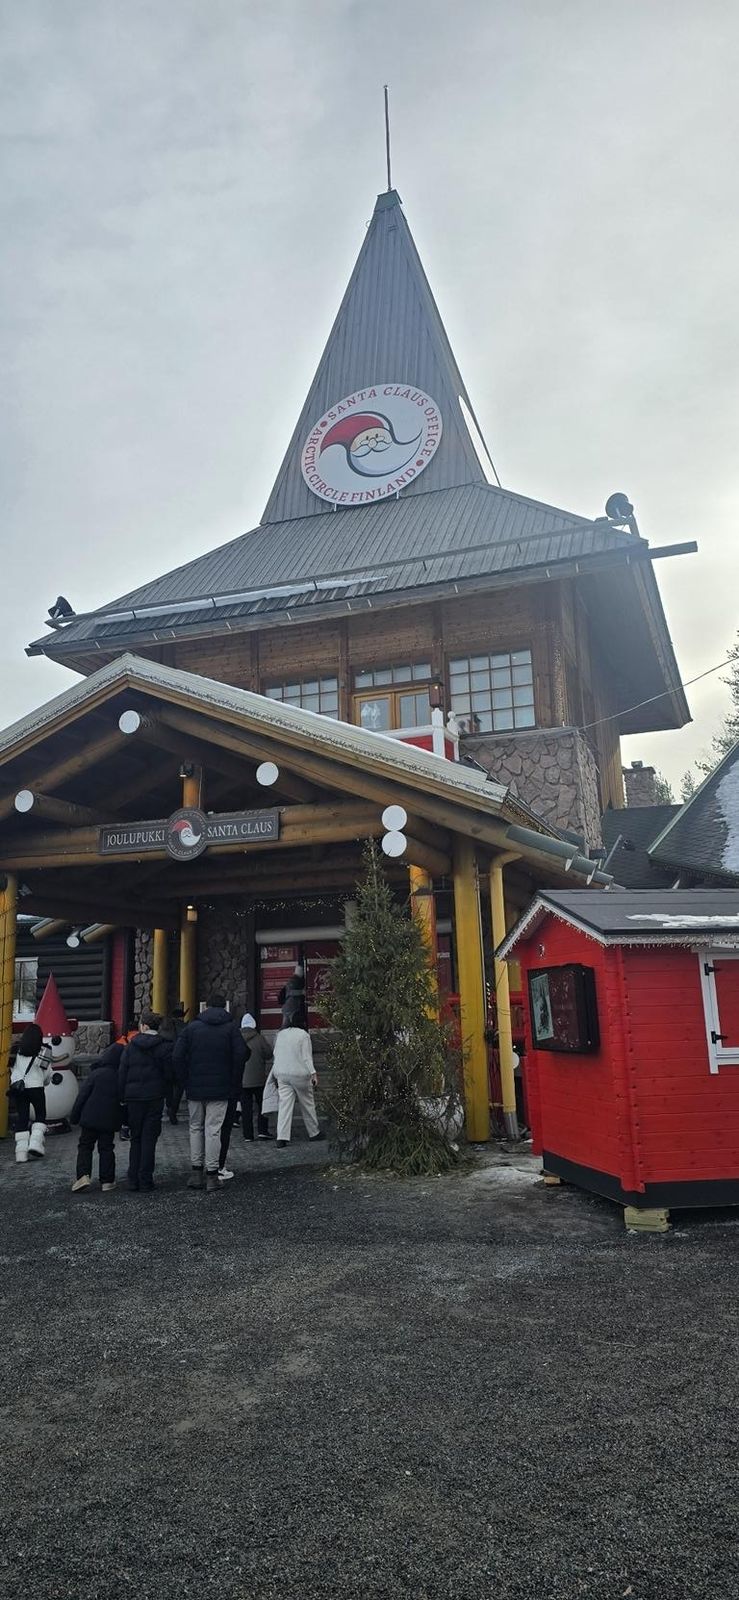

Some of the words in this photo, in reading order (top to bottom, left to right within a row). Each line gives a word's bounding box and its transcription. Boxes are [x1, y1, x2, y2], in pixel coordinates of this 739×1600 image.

[327, 388, 377, 421] SANTA
[383, 386, 428, 407] CLAUS
[422, 407, 439, 457] OFFICE
[304, 428, 323, 474] ARCTIC
[308, 474, 349, 502] CIRCLE
[350, 467, 416, 502] FINLAND
[106, 829, 165, 847] JOULUPUKKI
[207, 824, 238, 838] SANTA
[240, 820, 273, 834] CLAUS
